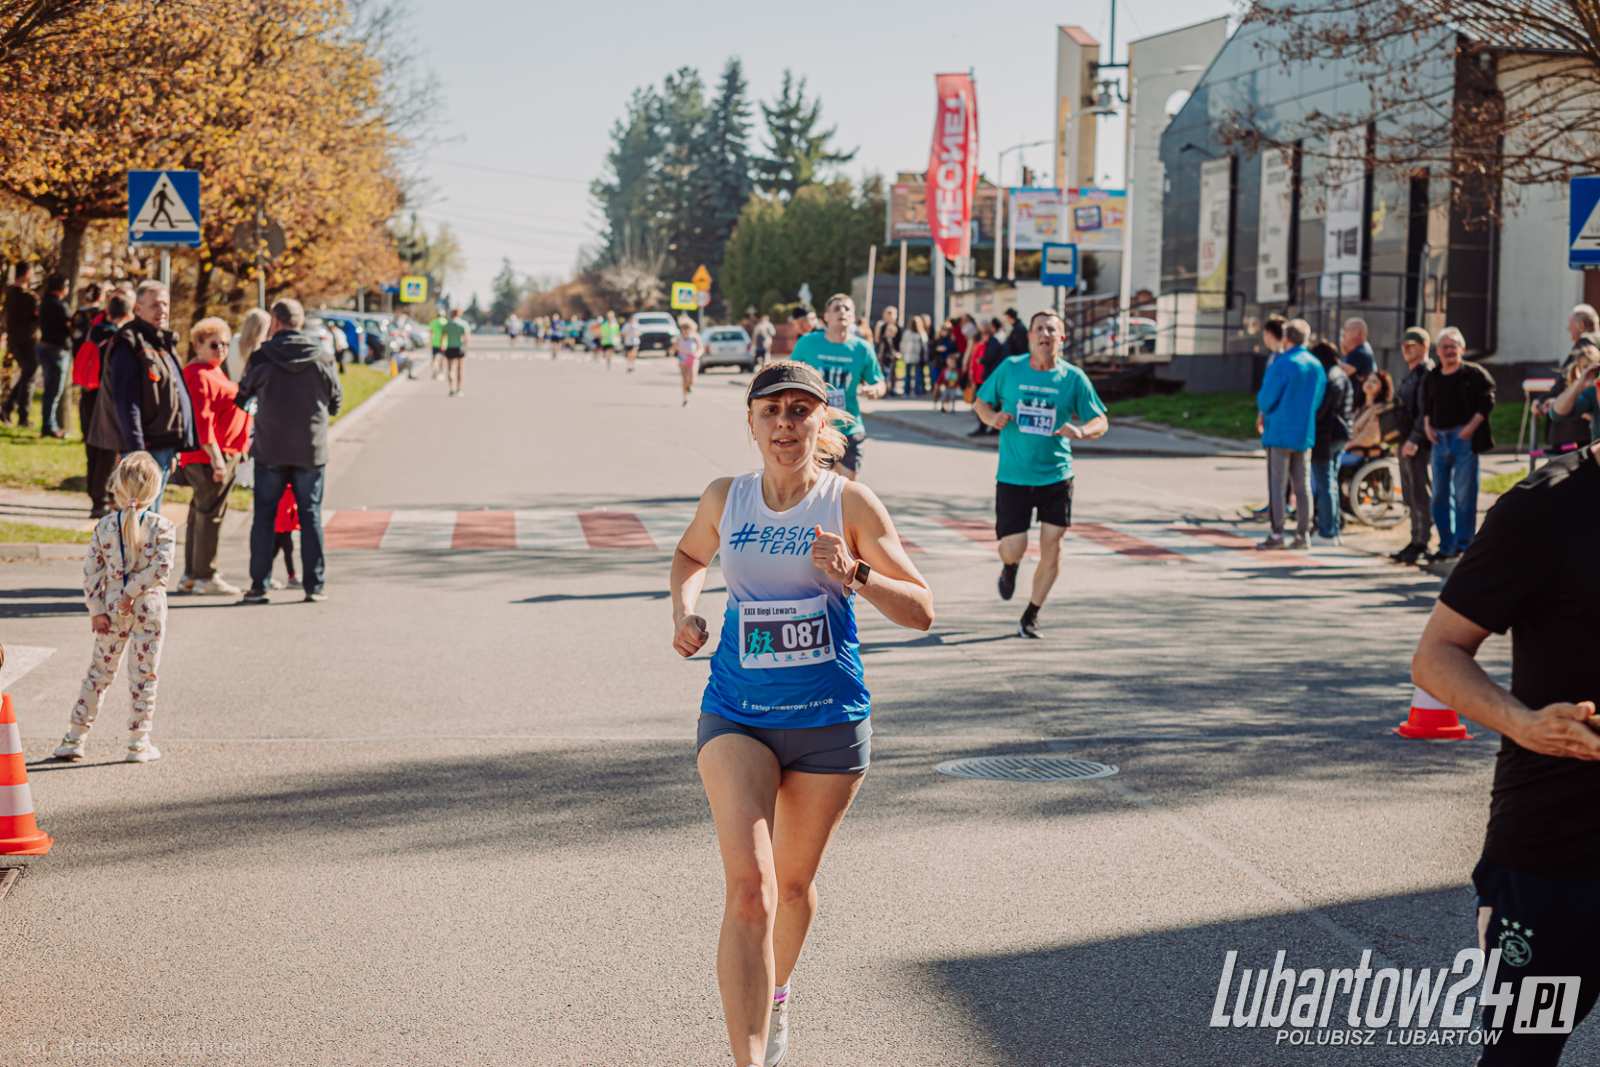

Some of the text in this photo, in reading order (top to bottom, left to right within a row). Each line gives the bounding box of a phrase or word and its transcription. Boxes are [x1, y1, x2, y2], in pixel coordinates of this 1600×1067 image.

[936, 90, 967, 239] NEONET
[729, 522, 816, 552] #BASIA
[744, 608, 756, 616] XXIX
[772, 606, 797, 615] Lewarta
[782, 619, 824, 649] 087
